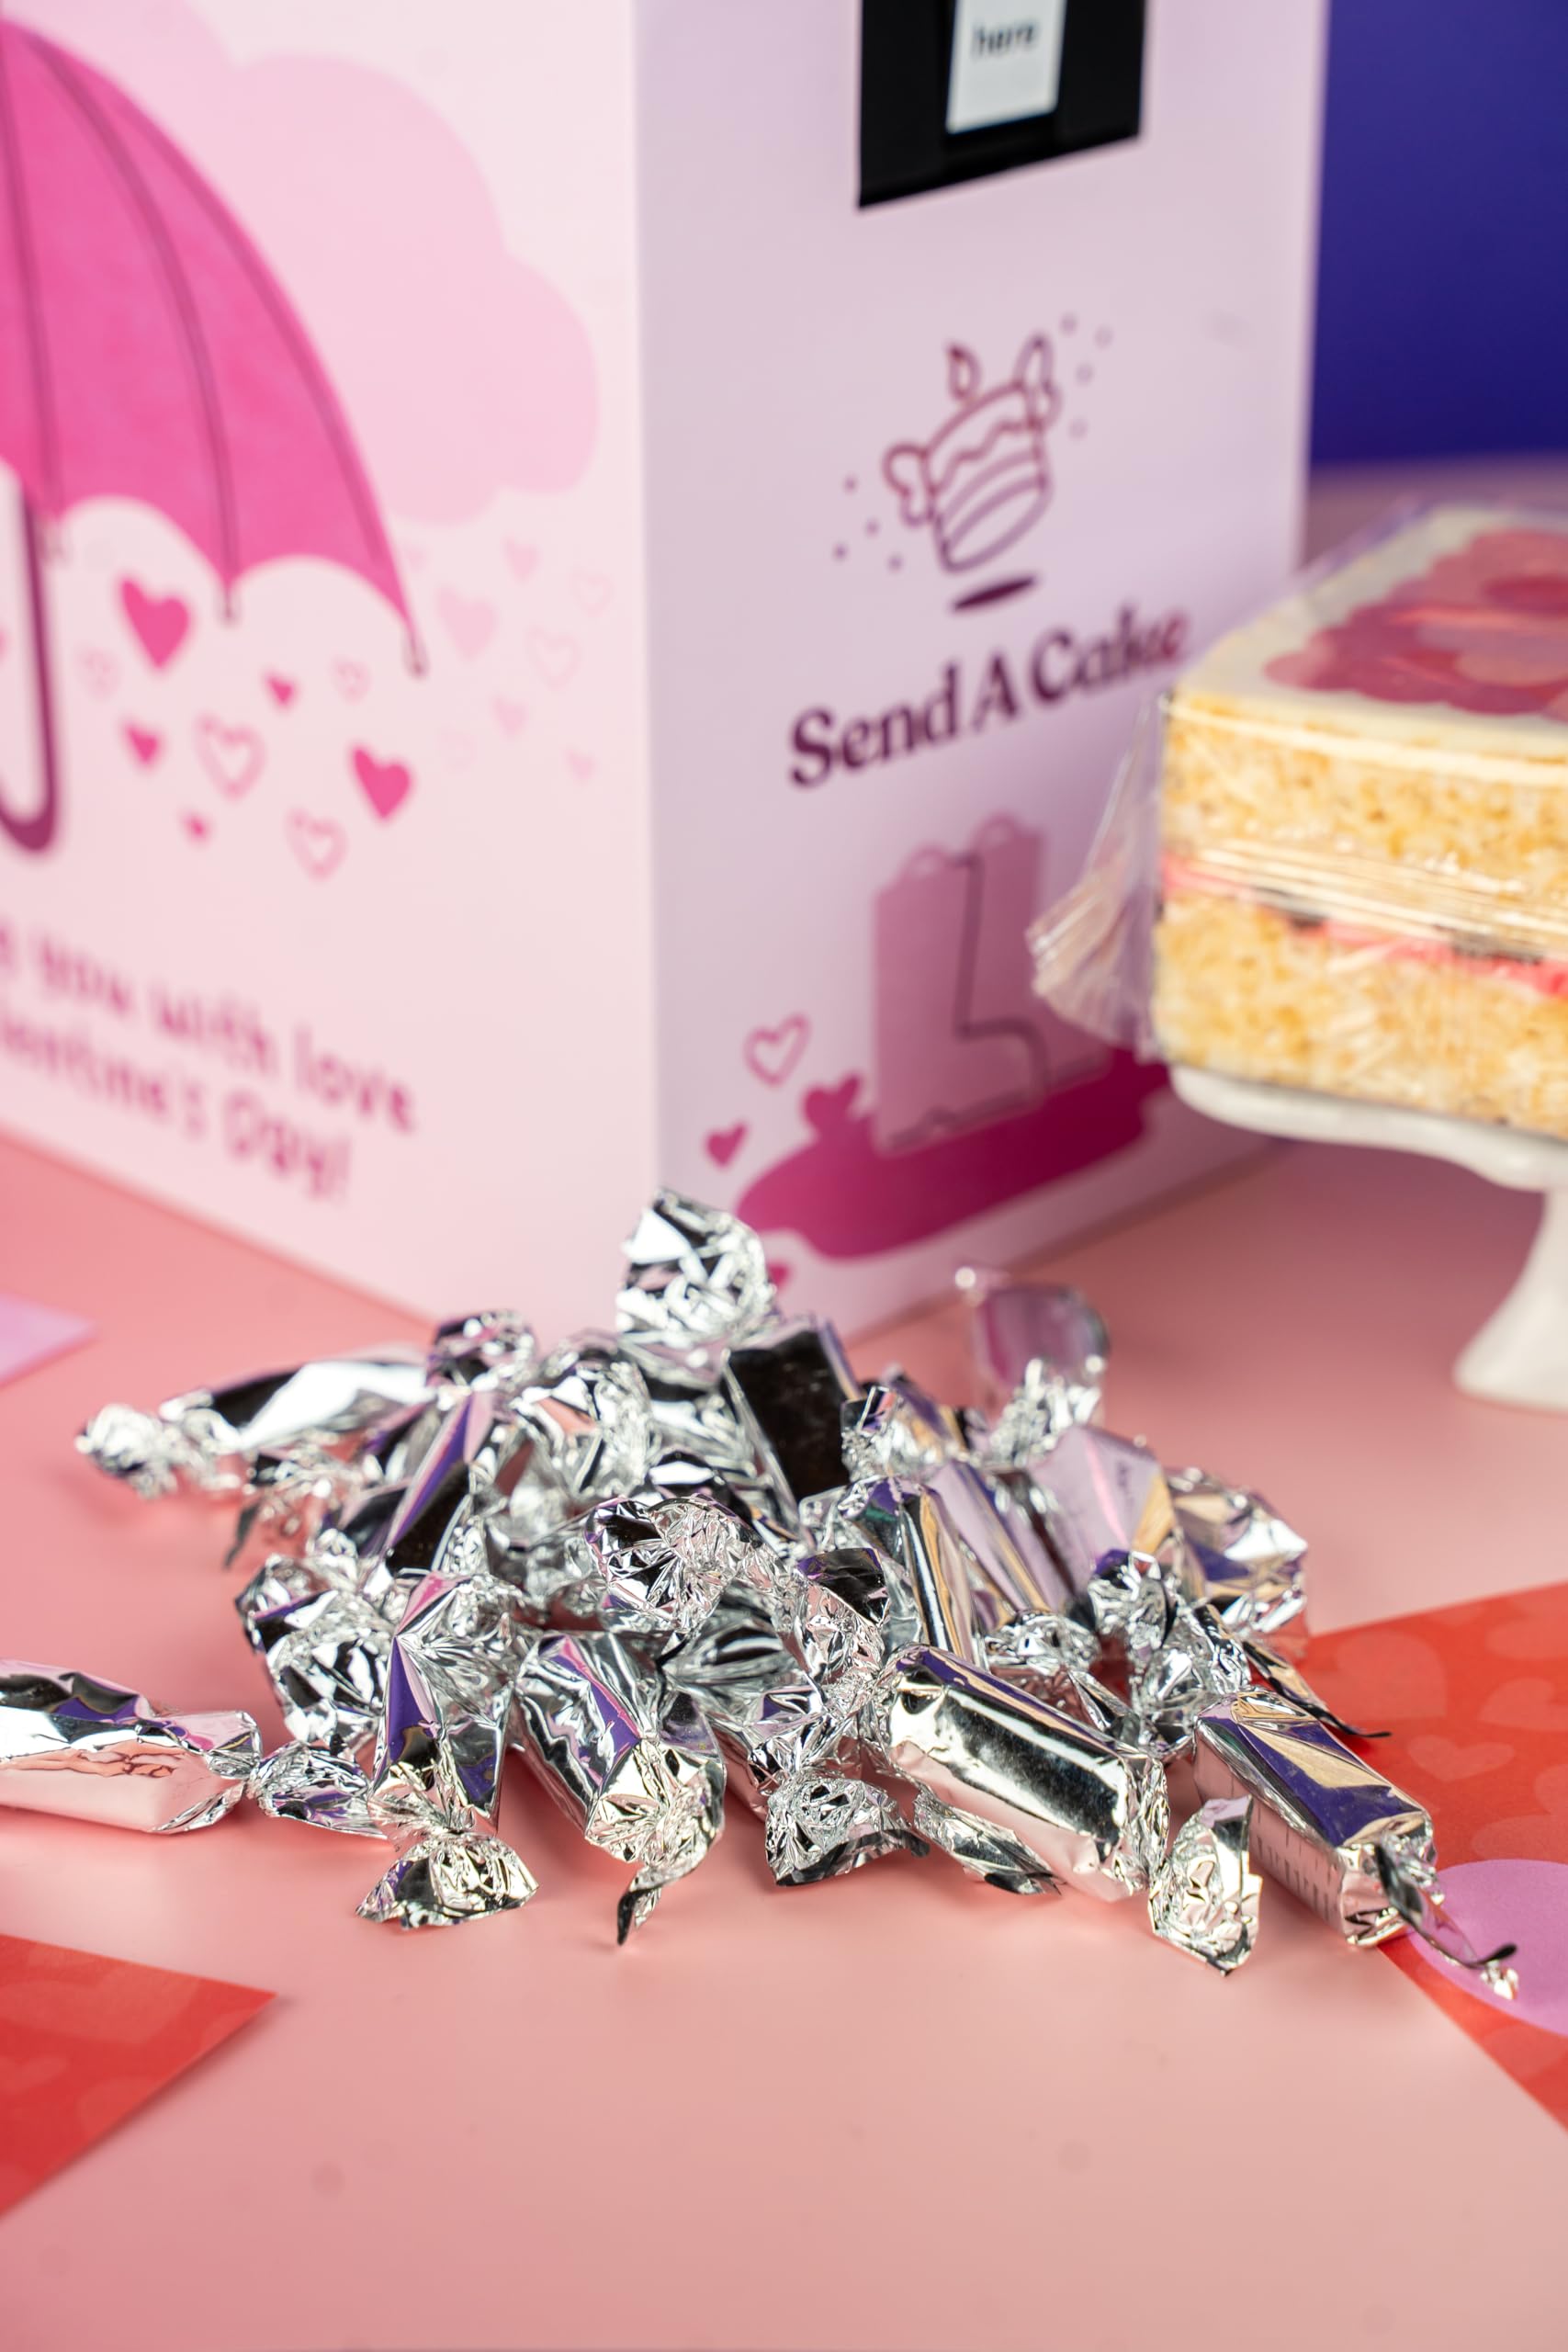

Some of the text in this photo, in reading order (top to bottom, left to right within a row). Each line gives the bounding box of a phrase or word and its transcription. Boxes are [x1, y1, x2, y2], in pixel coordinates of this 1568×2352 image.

[789, 603, 1190, 788] Send A Cake
[294, 1020, 414, 1134] love
